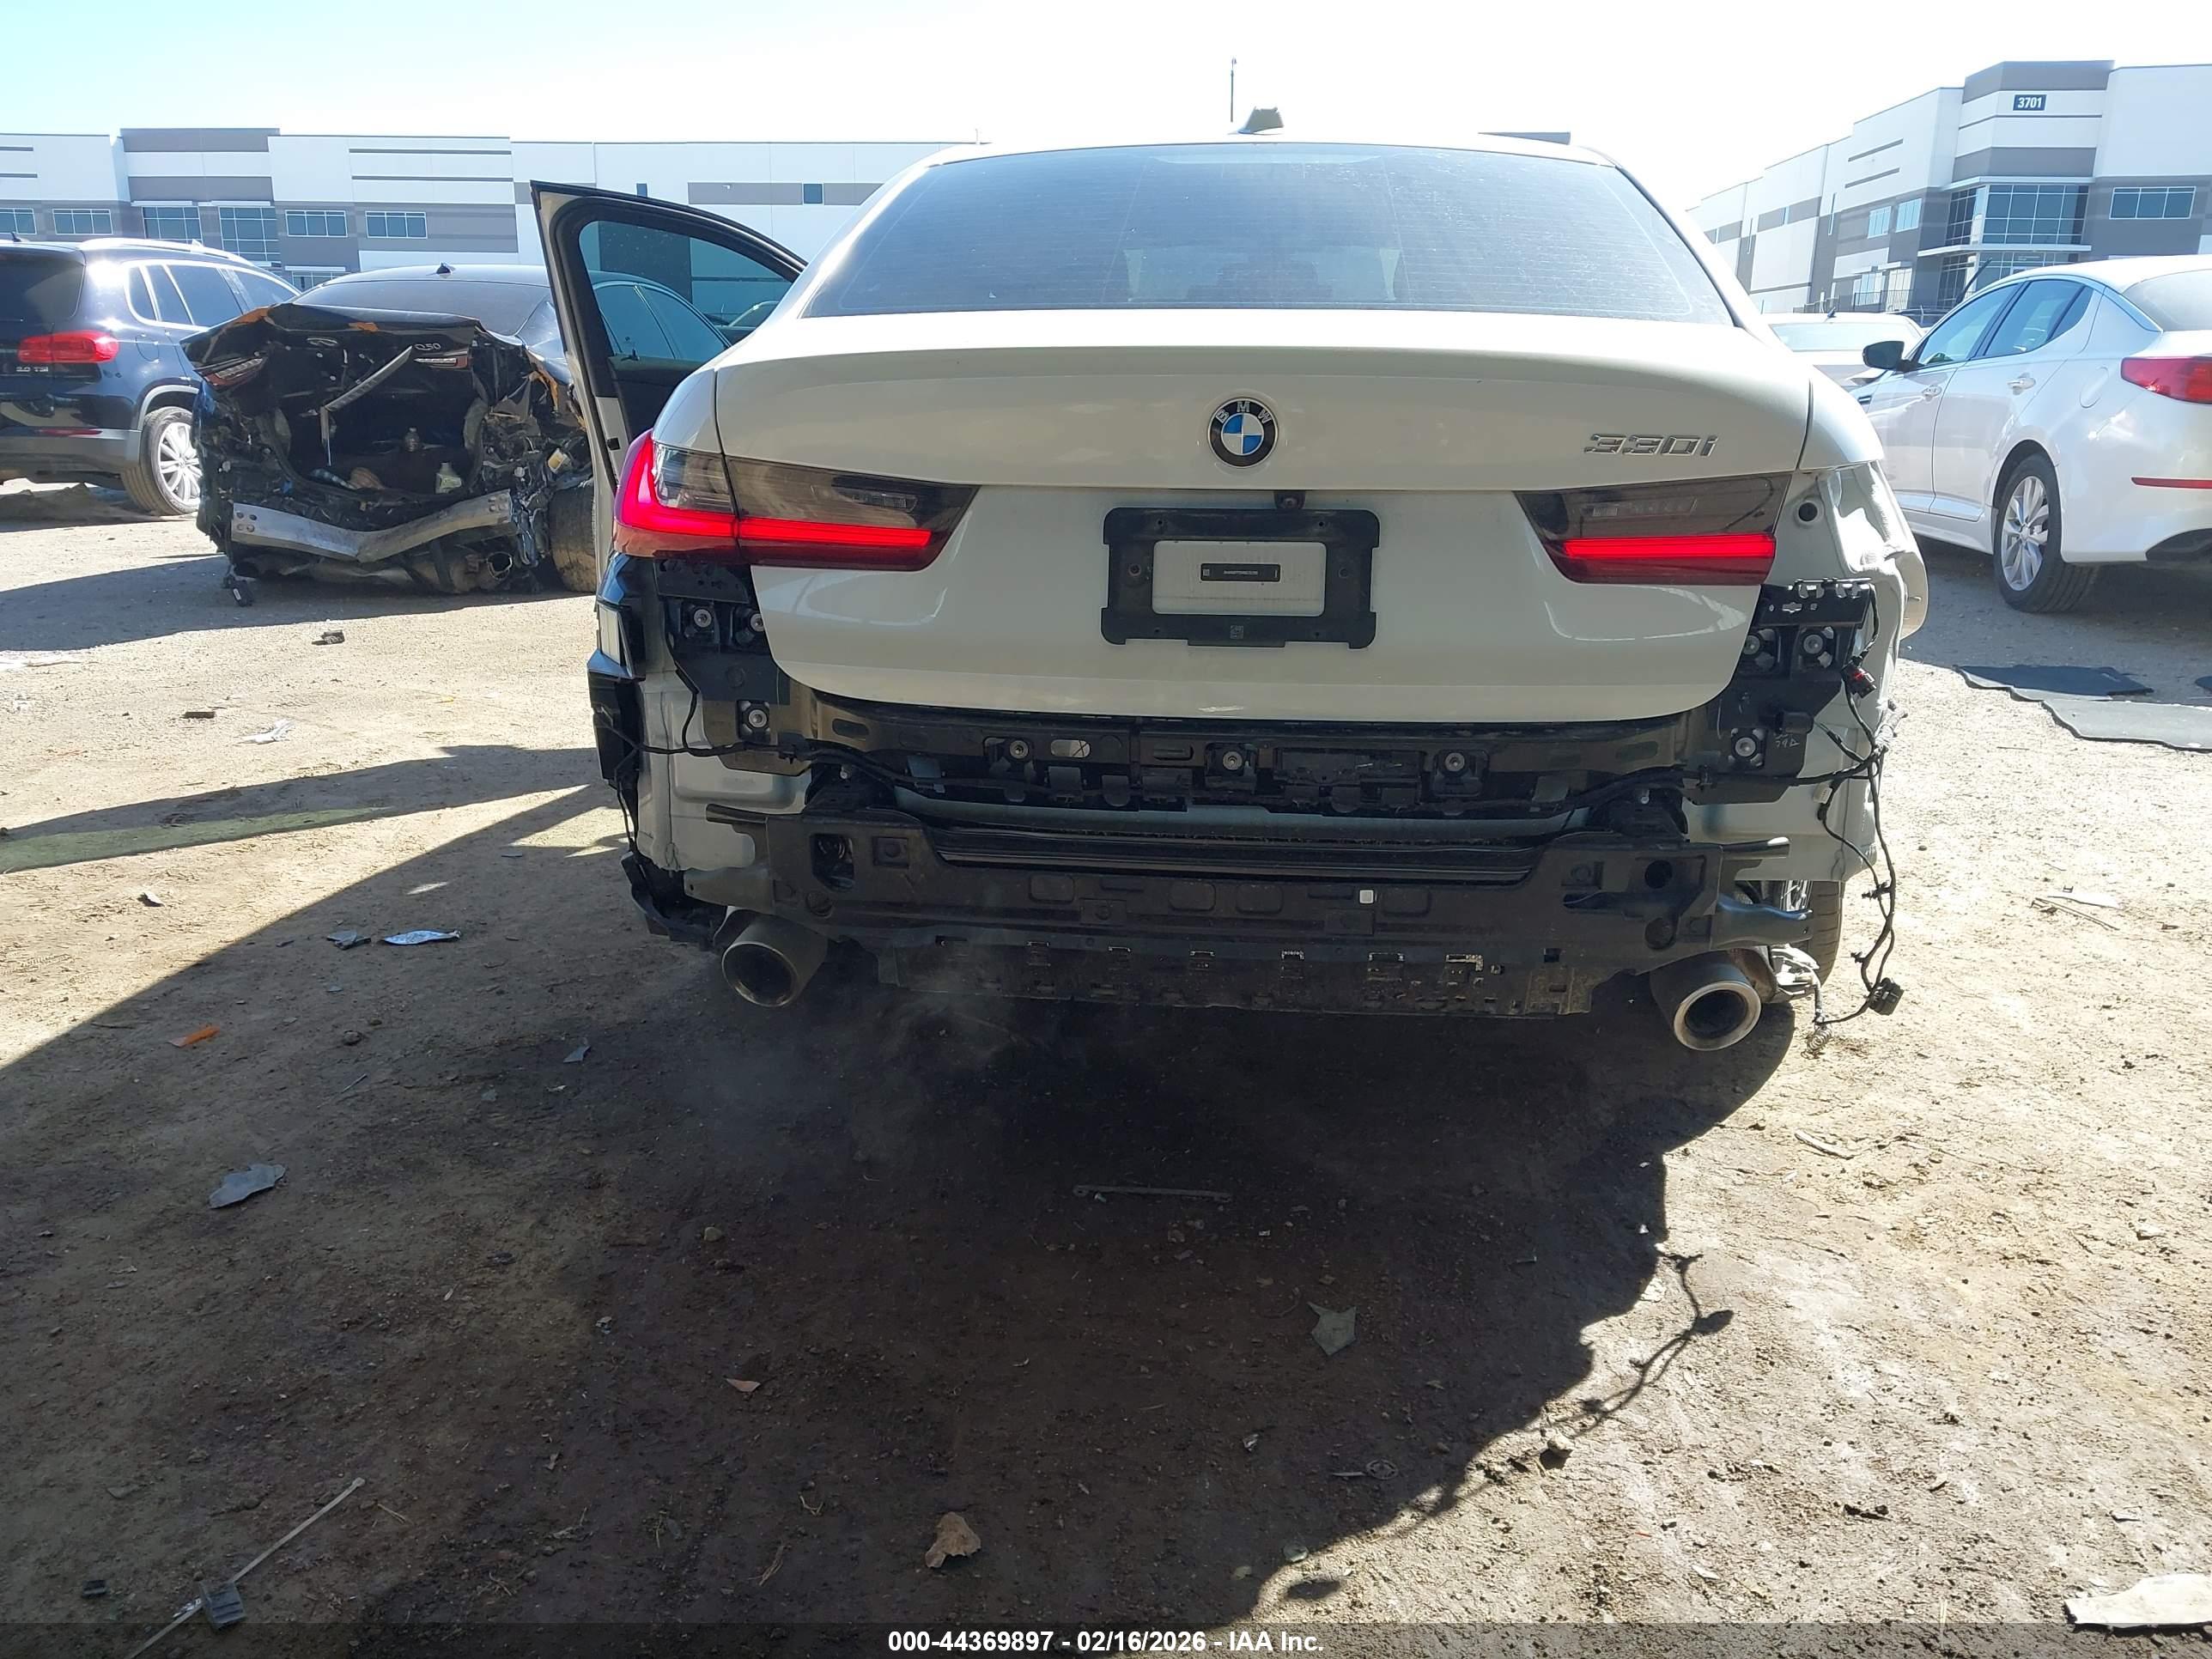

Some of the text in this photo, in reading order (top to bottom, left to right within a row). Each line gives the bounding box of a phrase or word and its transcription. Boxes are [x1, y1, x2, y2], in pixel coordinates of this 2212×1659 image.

[2017, 96, 2043, 109] 3701
[415, 343, 441, 351] Q50
[1215, 400, 1273, 424] BMW
[1583, 433, 1719, 457] 330i
